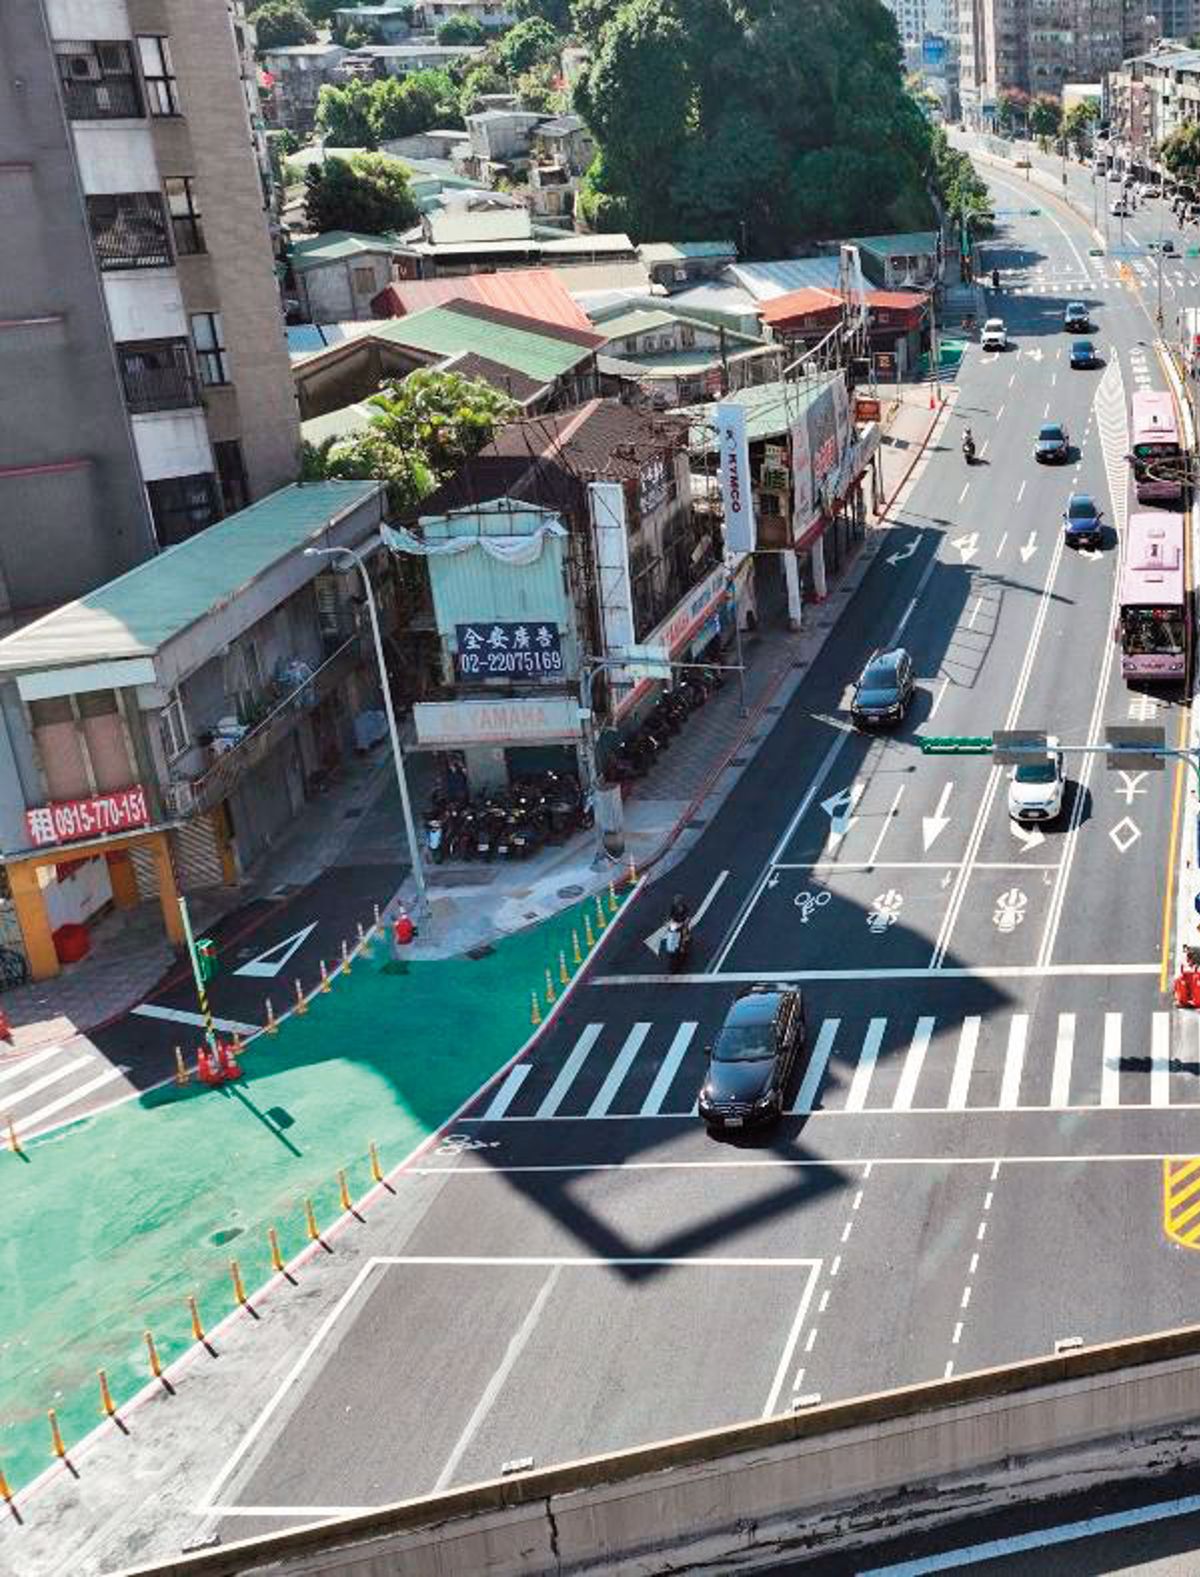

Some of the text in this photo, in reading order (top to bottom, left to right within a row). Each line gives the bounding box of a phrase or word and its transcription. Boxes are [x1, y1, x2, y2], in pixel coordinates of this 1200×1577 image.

[728, 452, 741, 513] KYMCO
[464, 625, 553, 650] 全安廣告
[461, 651, 562, 674] 02-22075169
[29, 792, 148, 844] 租 0915-770-151
